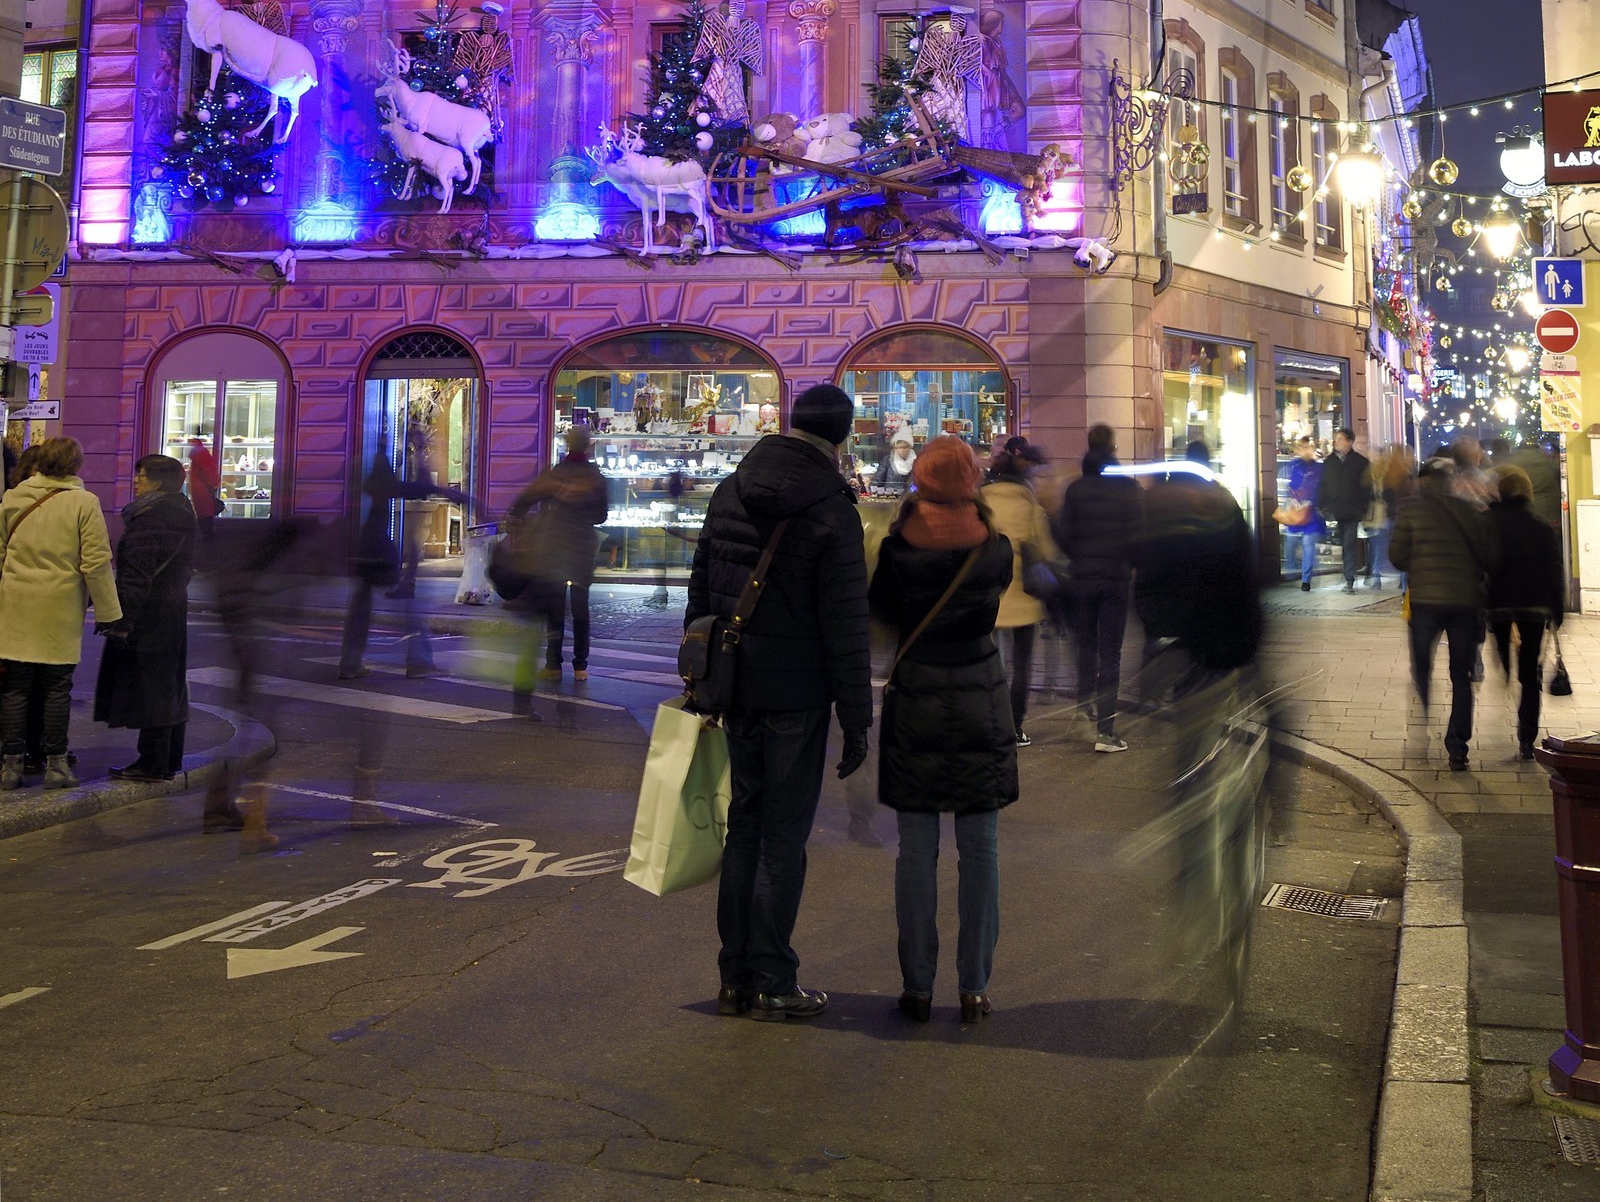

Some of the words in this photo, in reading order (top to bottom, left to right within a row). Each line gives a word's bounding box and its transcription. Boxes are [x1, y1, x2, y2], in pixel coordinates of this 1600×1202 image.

[25, 111, 40, 126] RUE
[2, 125, 17, 139] DES
[18, 125, 60, 148] ÉTUDIANTS
